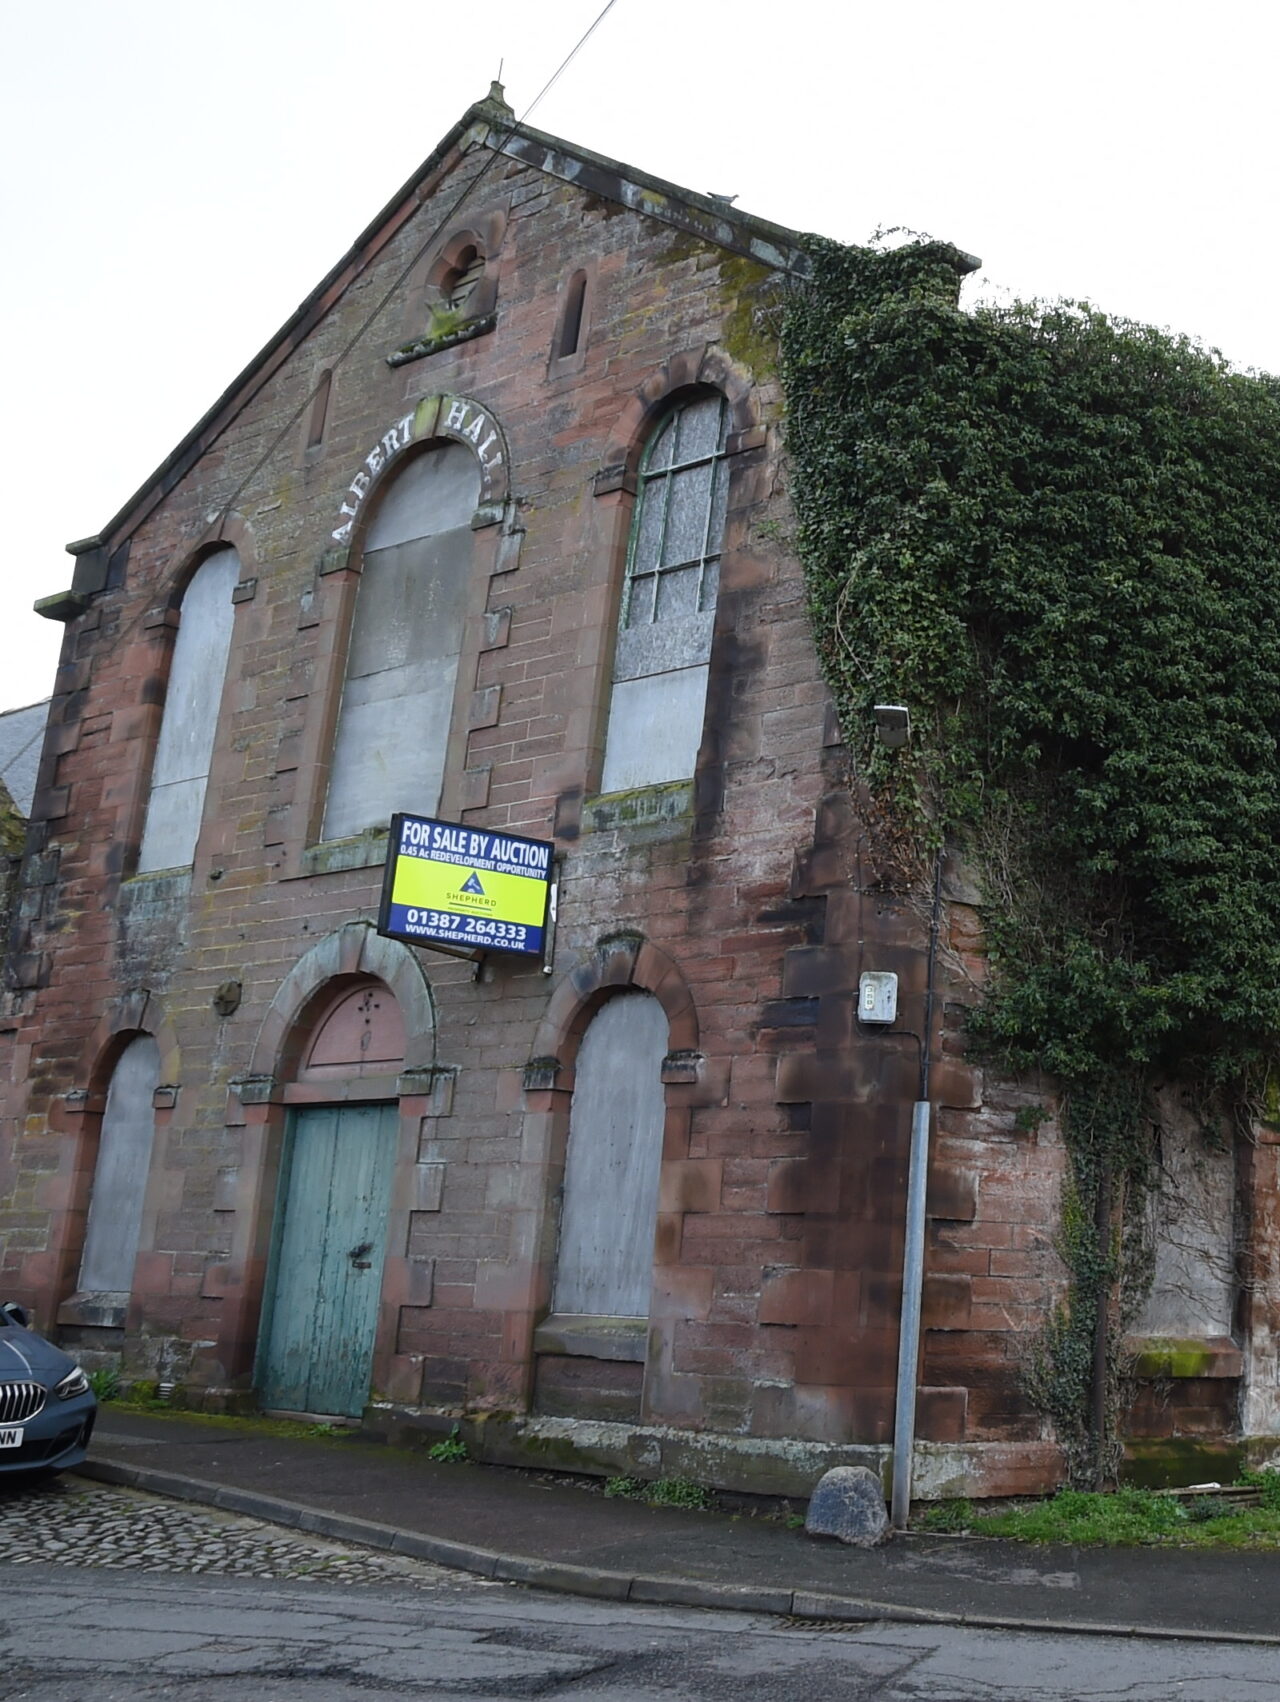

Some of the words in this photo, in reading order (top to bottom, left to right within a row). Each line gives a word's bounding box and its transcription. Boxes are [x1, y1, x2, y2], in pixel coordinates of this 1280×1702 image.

[331, 412, 415, 545] ALBERT
[402, 821, 430, 846] FOR
[433, 827, 467, 853] SALE
[469, 833, 489, 857] BY
[490, 839, 549, 869] AUCTION
[400, 844, 417, 857] 0.45
[419, 847, 429, 858] Ac
[430, 850, 495, 871] REDEVELOPMENT
[496, 860, 547, 880] OPPORTUNITY
[446, 892, 497, 907] SHEPHERD
[405, 923, 525, 950] WWW.SHEPHERD.CO.UK
[407, 909, 461, 929] 01387
[465, 918, 527, 940] 264333
